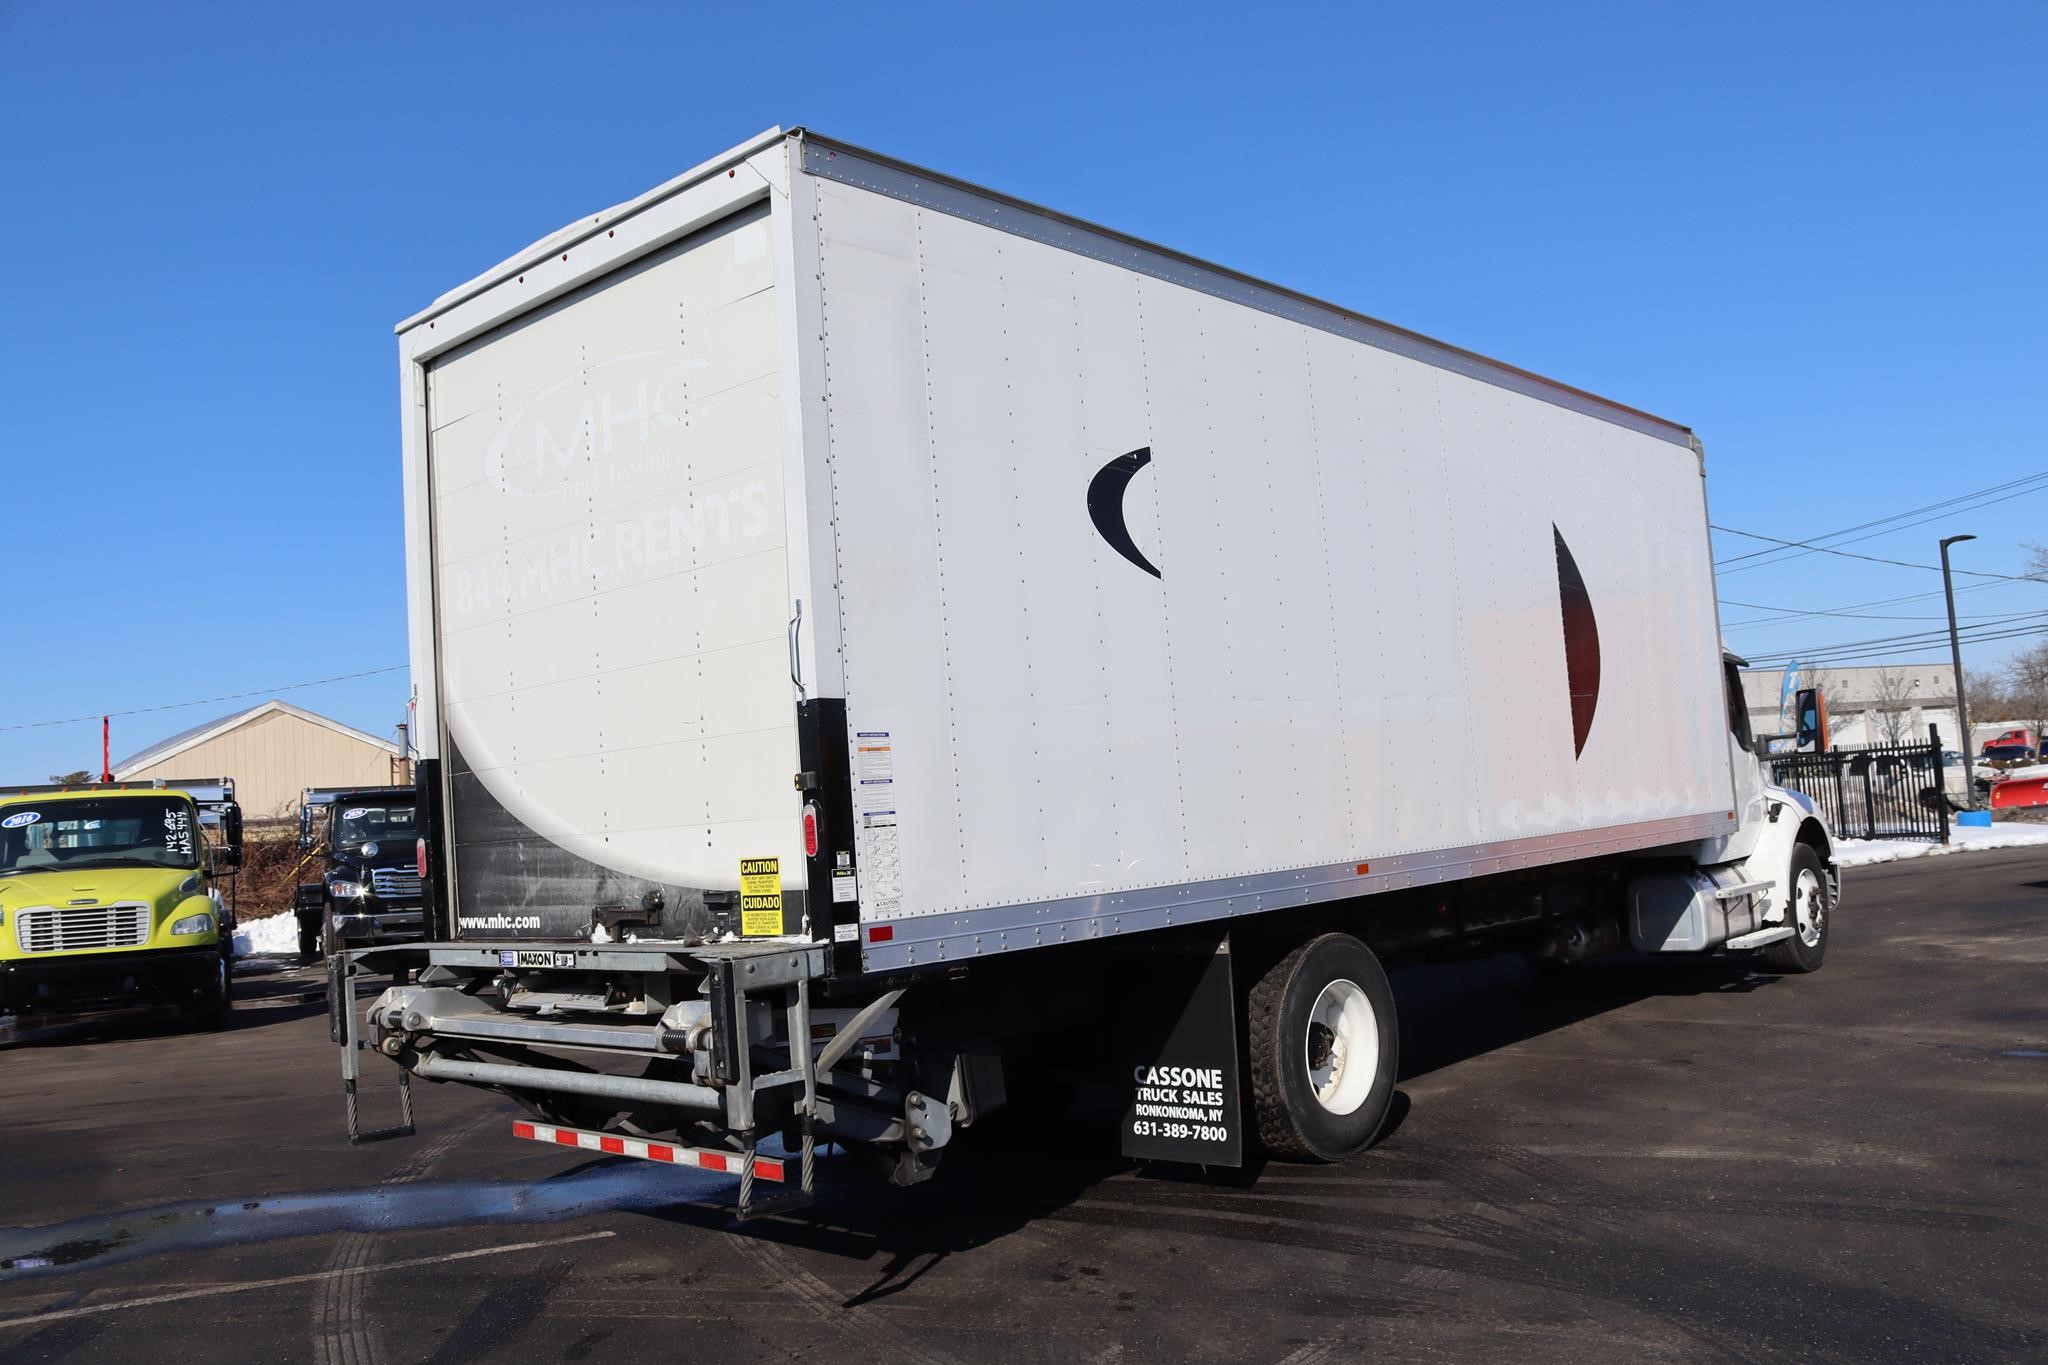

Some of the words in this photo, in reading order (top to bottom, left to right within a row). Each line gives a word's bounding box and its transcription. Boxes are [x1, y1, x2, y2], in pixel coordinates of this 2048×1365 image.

[8, 814, 34, 827] 2016
[742, 861, 777, 873] CAUTION
[744, 896, 779, 909] CUIDADO
[459, 913, 541, 929] www.mhc.com
[520, 953, 552, 966] MAXON
[1134, 1065, 1223, 1089] CASSONE
[1135, 1087, 1178, 1103] TRUCK
[1182, 1089, 1224, 1106] SALES
[1135, 1104, 1208, 1122] RONKONKOMA,
[1208, 1109, 1223, 1121] NY
[1133, 1121, 1228, 1142] 631-389-7800
